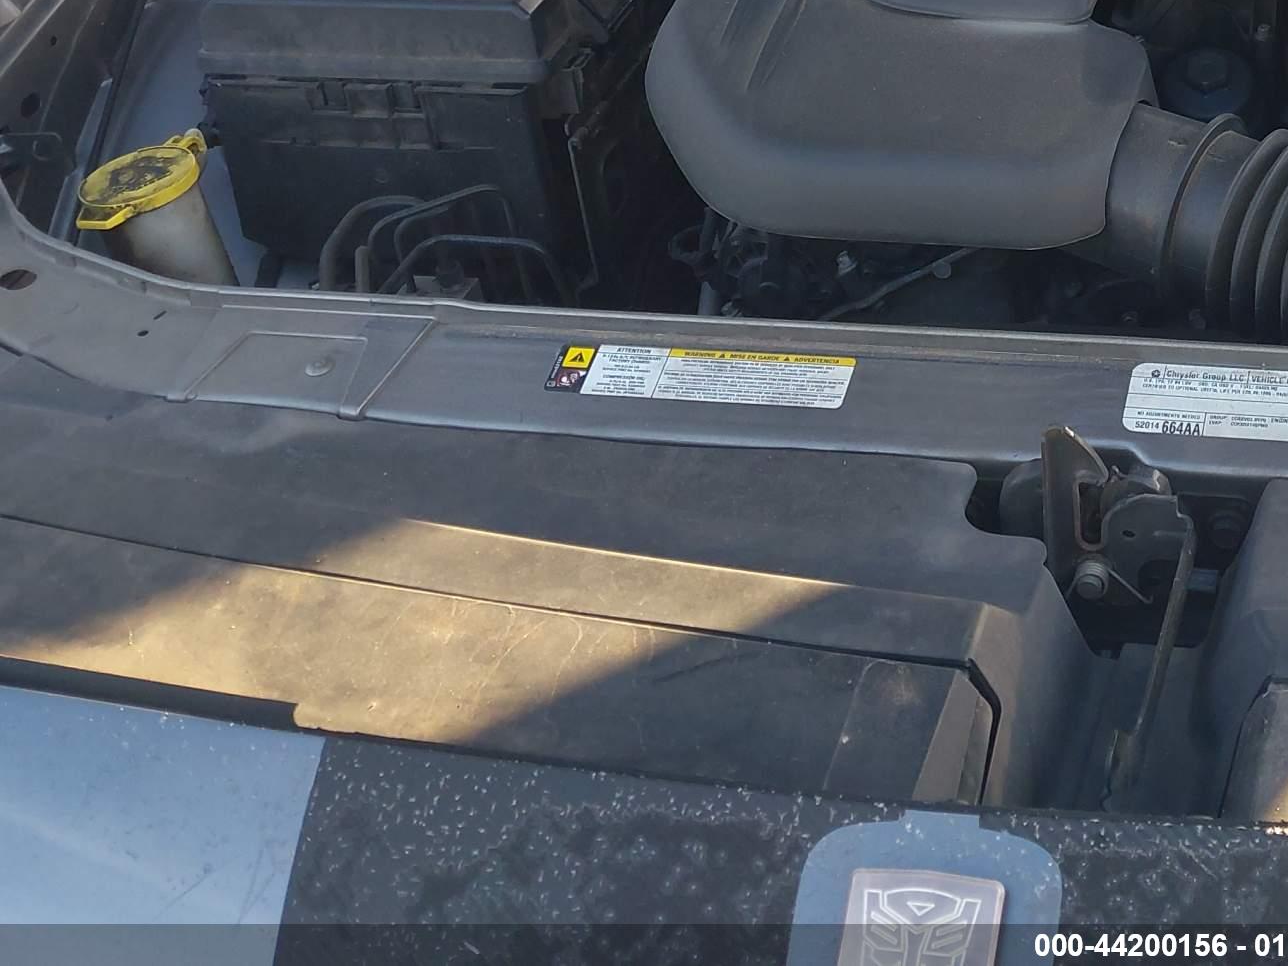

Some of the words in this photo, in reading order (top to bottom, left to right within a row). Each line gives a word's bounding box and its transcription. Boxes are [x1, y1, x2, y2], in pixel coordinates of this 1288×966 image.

[1166, 370, 1200, 380] Chrysler
[1202, 372, 1226, 382] Group
[1229, 372, 1245, 382] LLC
[1251, 375, 1285, 385] VEHICLE
[1135, 420, 1159, 430] 52014
[1161, 420, 1200, 436] 664AA
